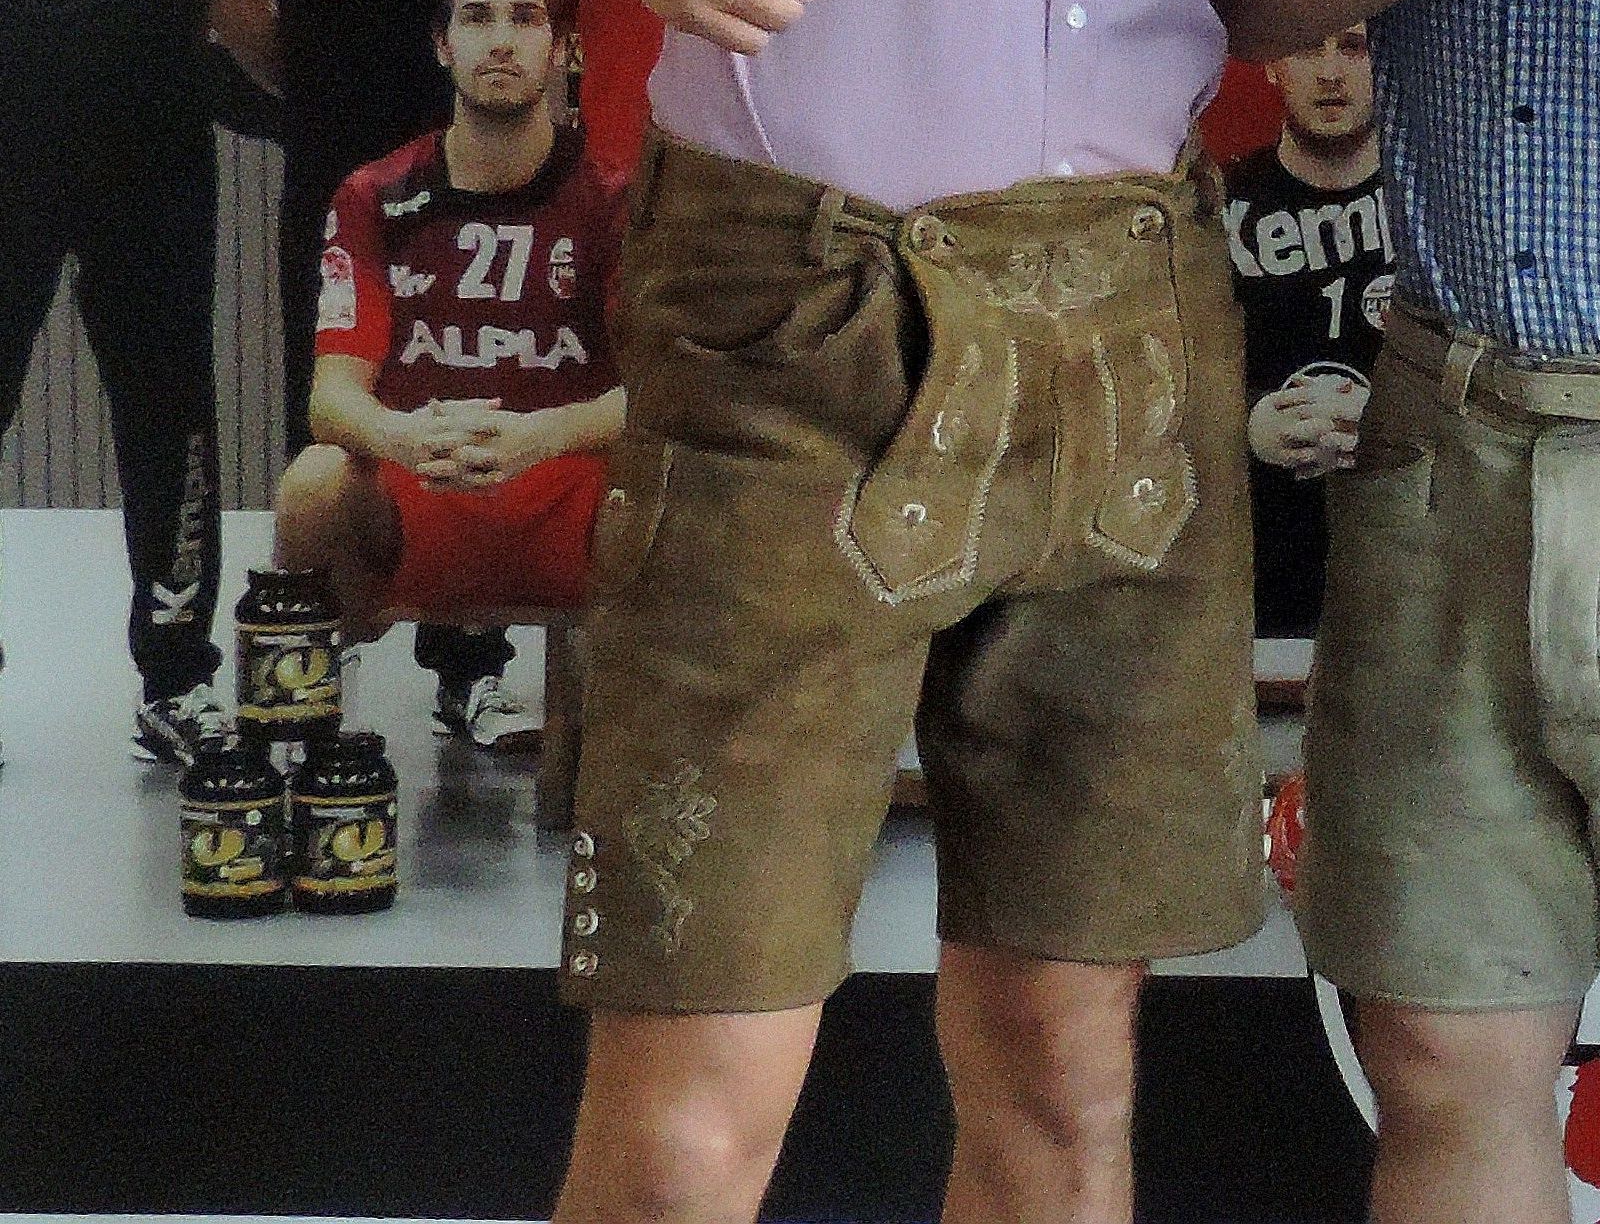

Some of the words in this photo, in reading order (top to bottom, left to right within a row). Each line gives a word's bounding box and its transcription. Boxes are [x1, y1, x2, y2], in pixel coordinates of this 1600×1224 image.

[457, 222, 534, 301] 27
[1320, 277, 1346, 339] 1
[400, 320, 588, 369] ALPLA
